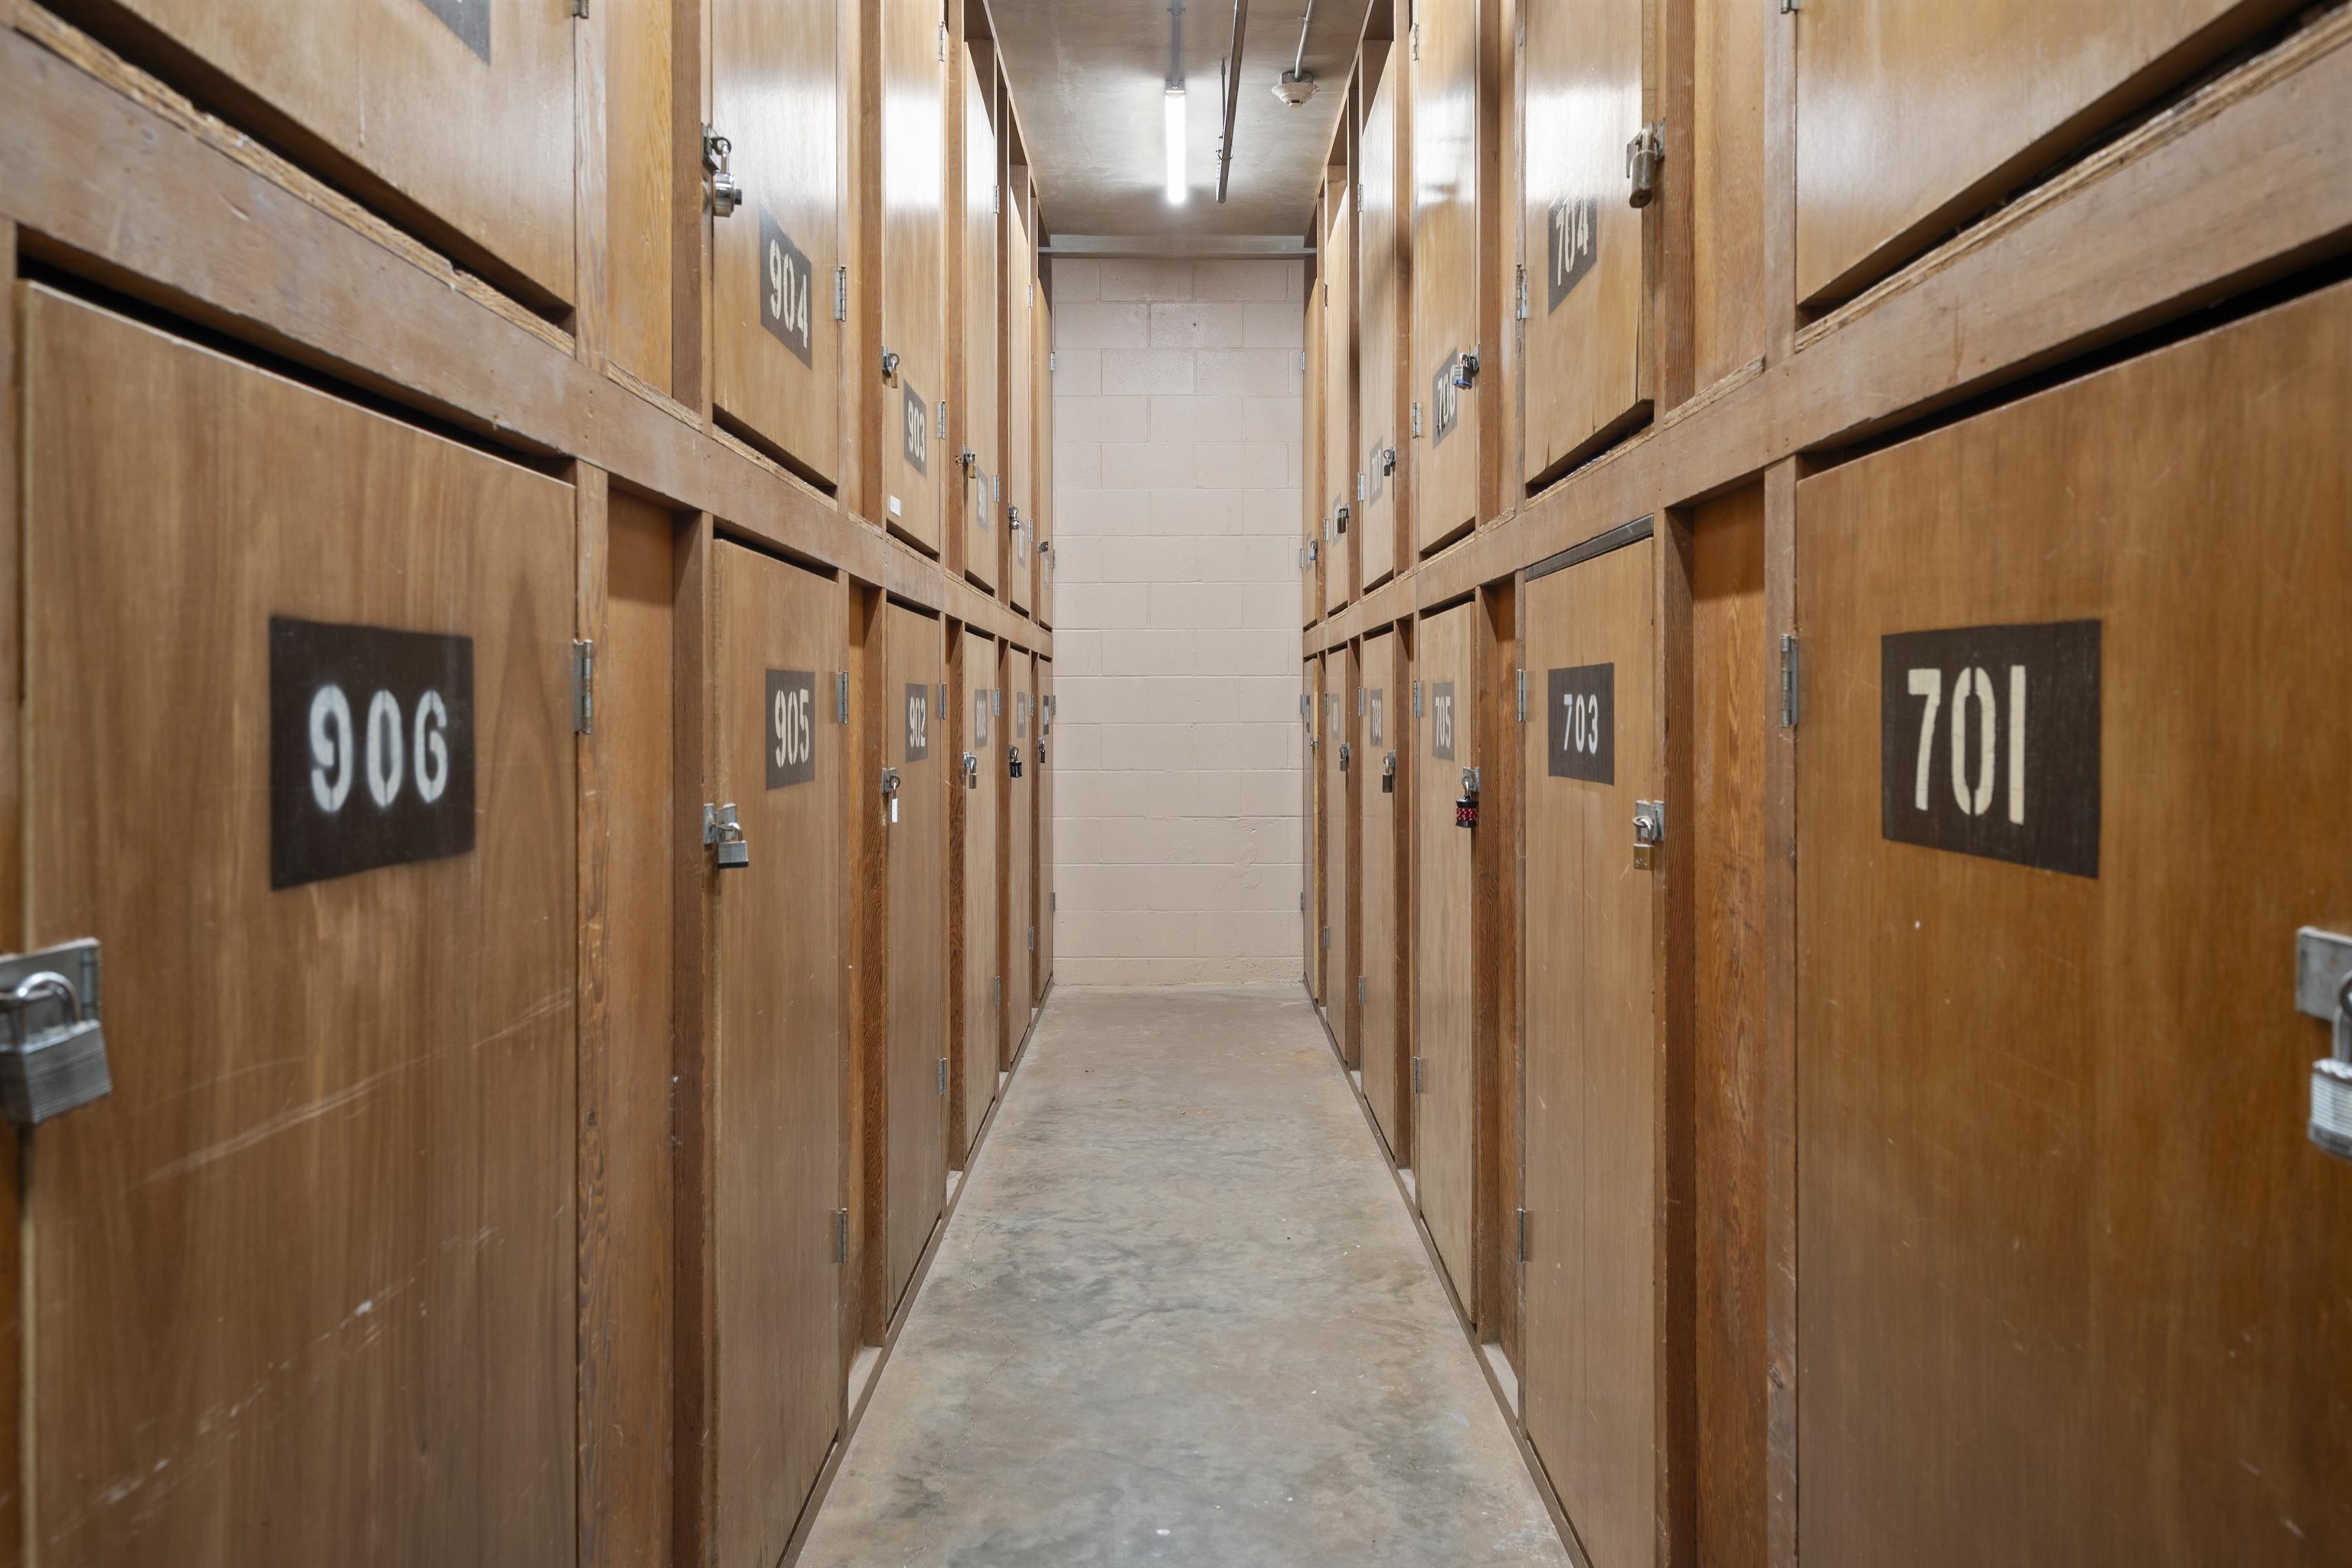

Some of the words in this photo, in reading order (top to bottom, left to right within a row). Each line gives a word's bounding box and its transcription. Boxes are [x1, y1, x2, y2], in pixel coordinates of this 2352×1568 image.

[1556, 200, 1589, 286] 704
[769, 239, 808, 349] 904
[908, 399, 926, 462] 903
[1438, 364, 1456, 431] 706
[311, 684, 447, 812] 906
[775, 688, 809, 768] 905
[910, 696, 926, 748] 902
[1436, 695, 1452, 749] 705
[1563, 694, 1599, 754] 703
[1907, 664, 2027, 825] 701
